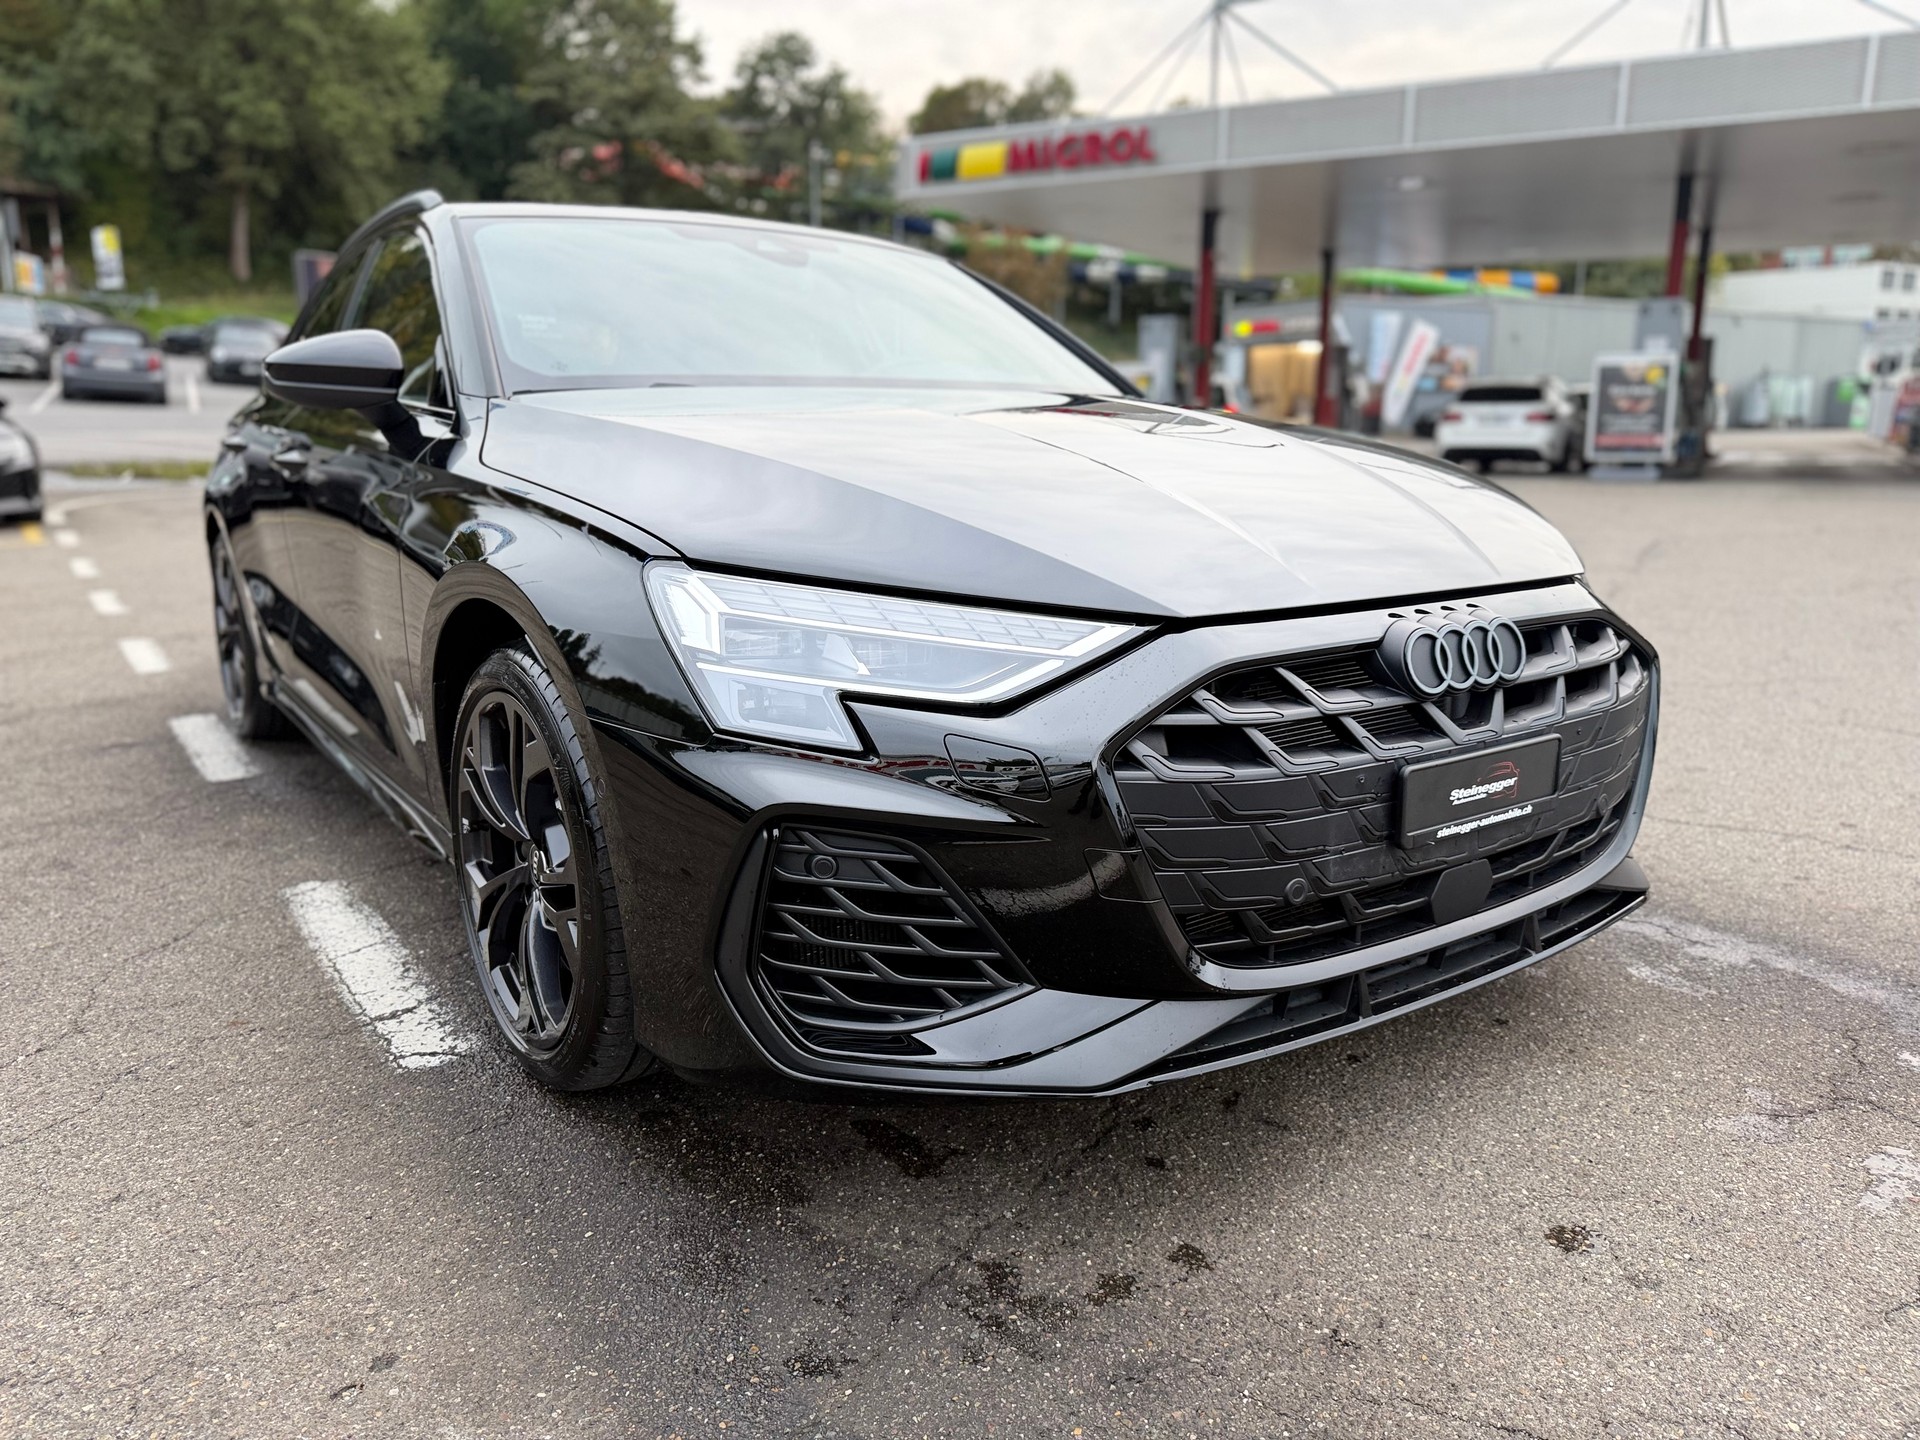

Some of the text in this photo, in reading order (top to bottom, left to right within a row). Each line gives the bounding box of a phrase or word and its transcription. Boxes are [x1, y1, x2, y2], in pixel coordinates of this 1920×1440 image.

[1007, 126, 1157, 174] MIGROL
[1449, 776, 1518, 801] Steinegger
[1436, 804, 1533, 839] steinegger-automobile.ch
